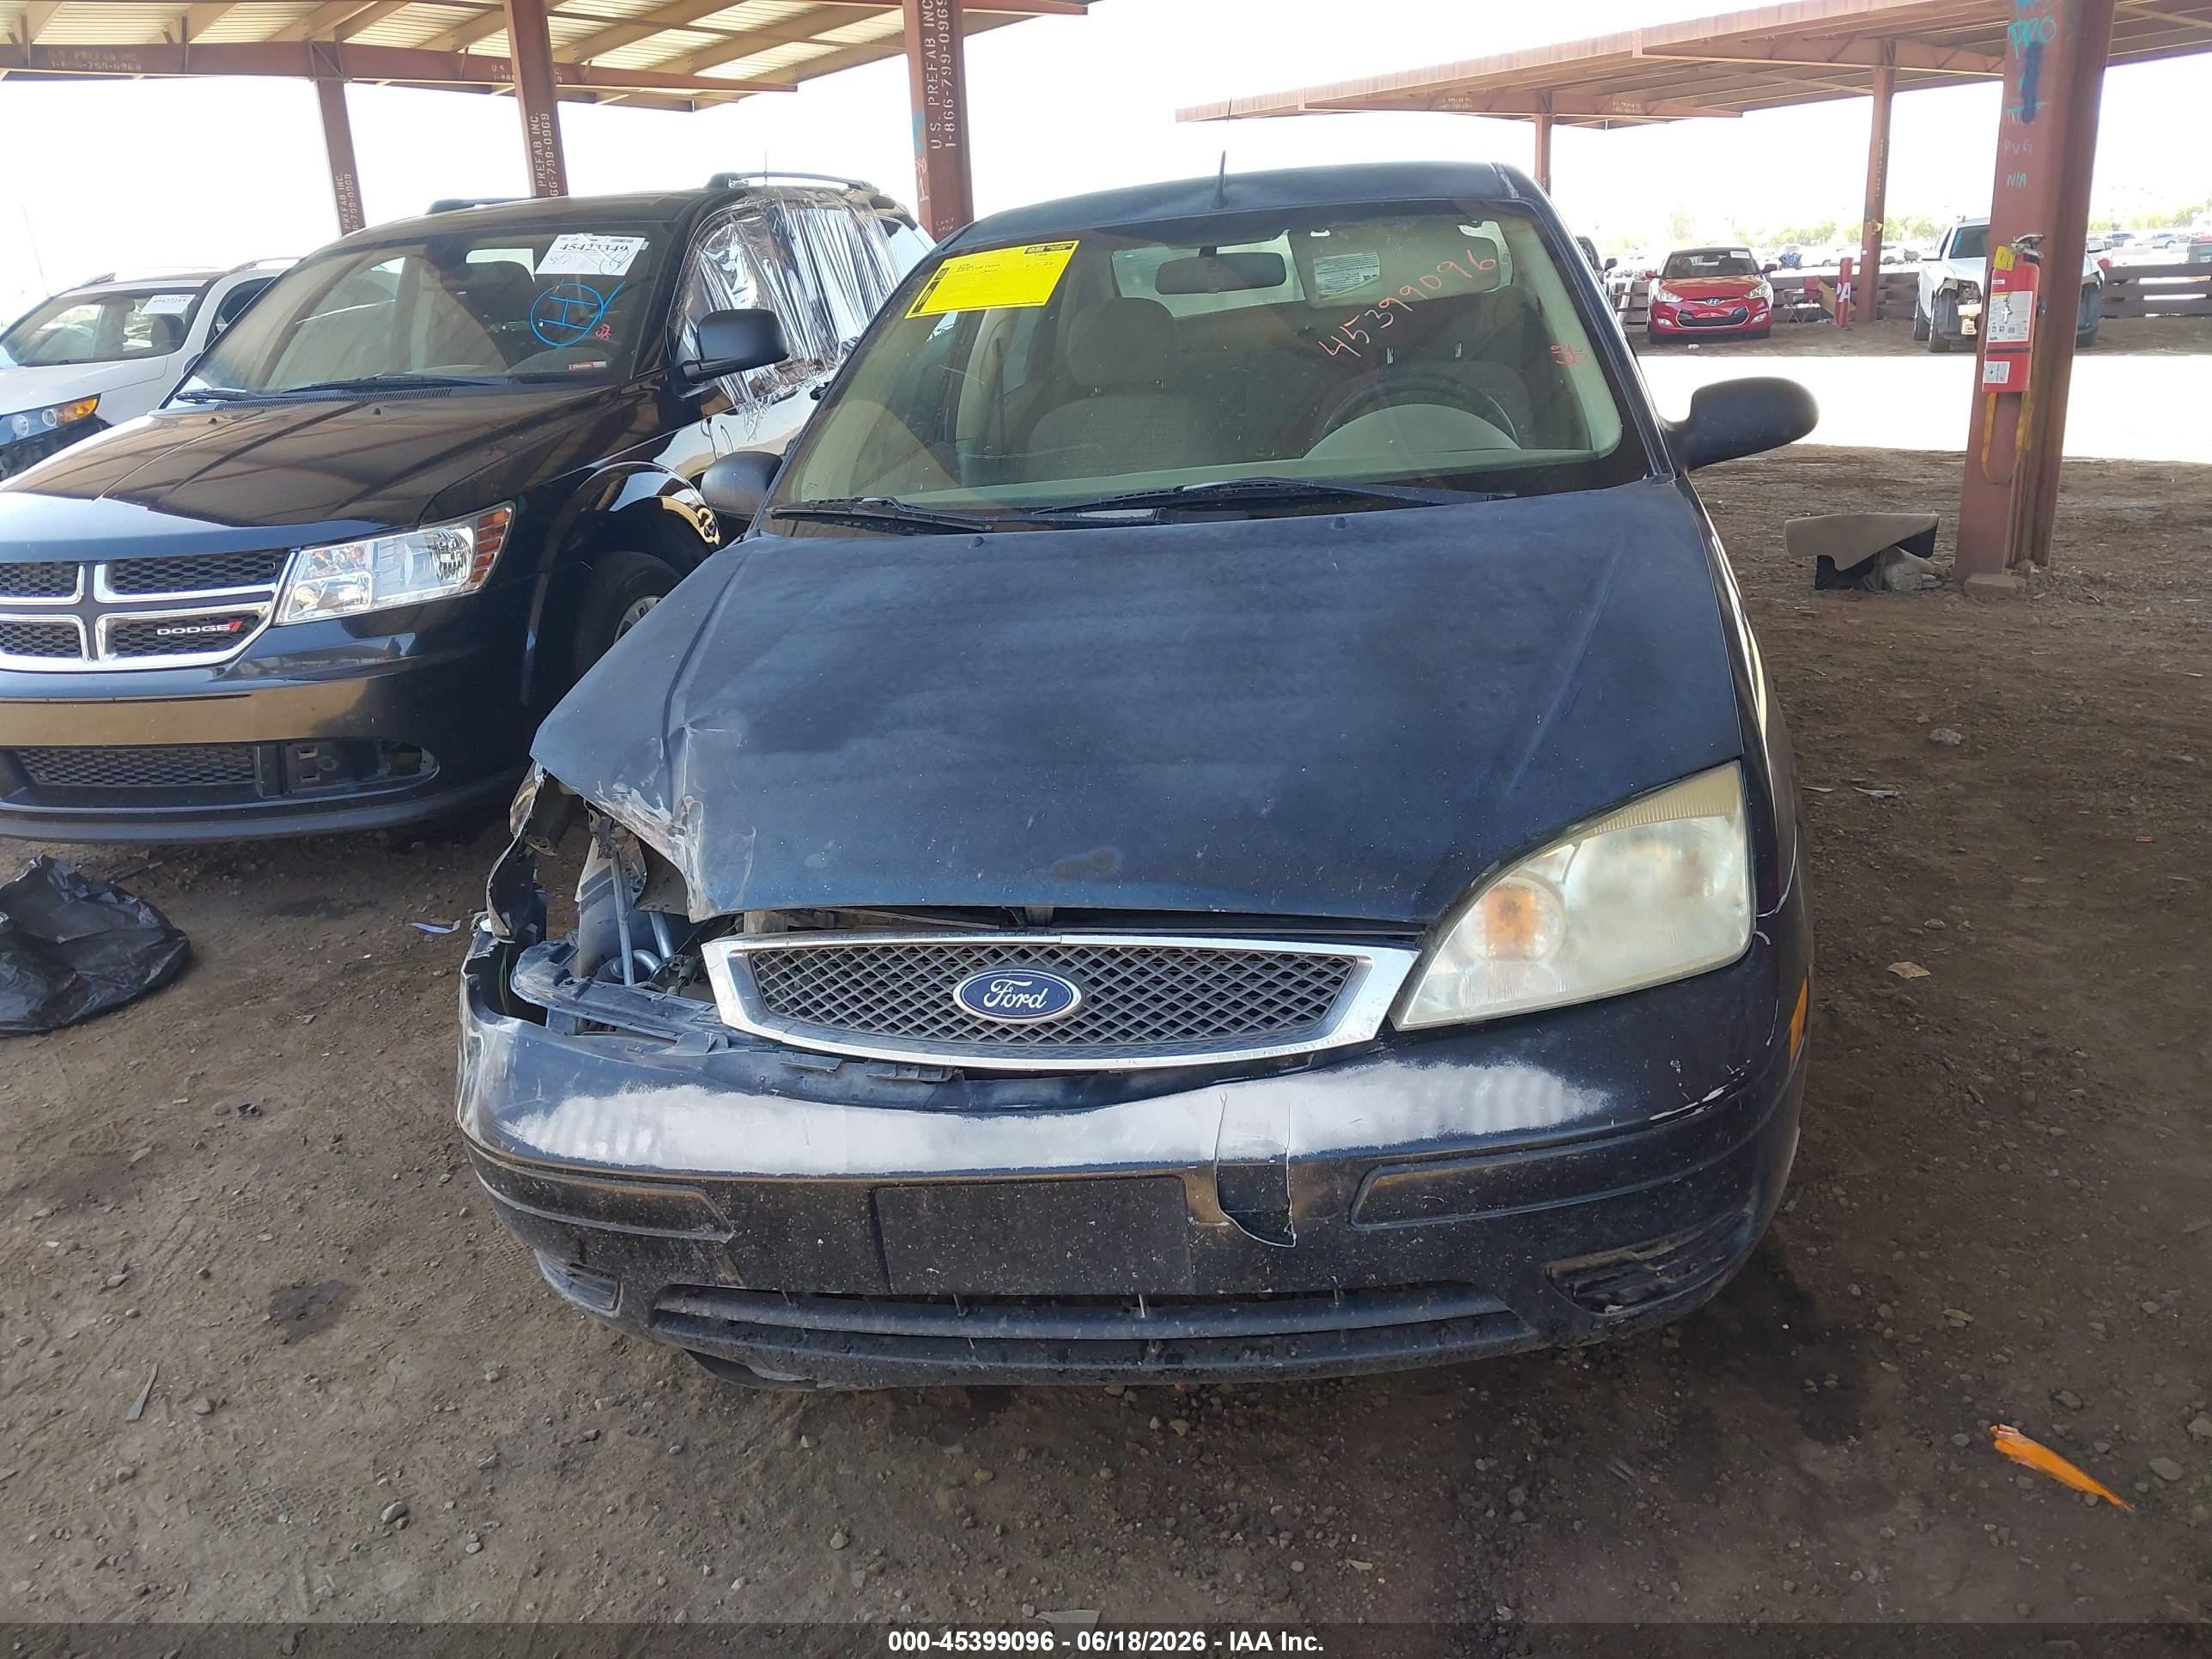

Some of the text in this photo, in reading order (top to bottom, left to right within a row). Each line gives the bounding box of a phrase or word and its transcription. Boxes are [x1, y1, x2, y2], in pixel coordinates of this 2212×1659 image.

[925, 38, 940, 106] PREFAB
[530, 112, 548, 186] PREFAB INC.
[540, 113, 559, 197] 66-799-0969
[931, 117, 942, 149] U.S.
[1318, 248, 1497, 359] 45399096
[156, 624, 231, 635] DODGE
[983, 979, 1049, 1009] Ford
